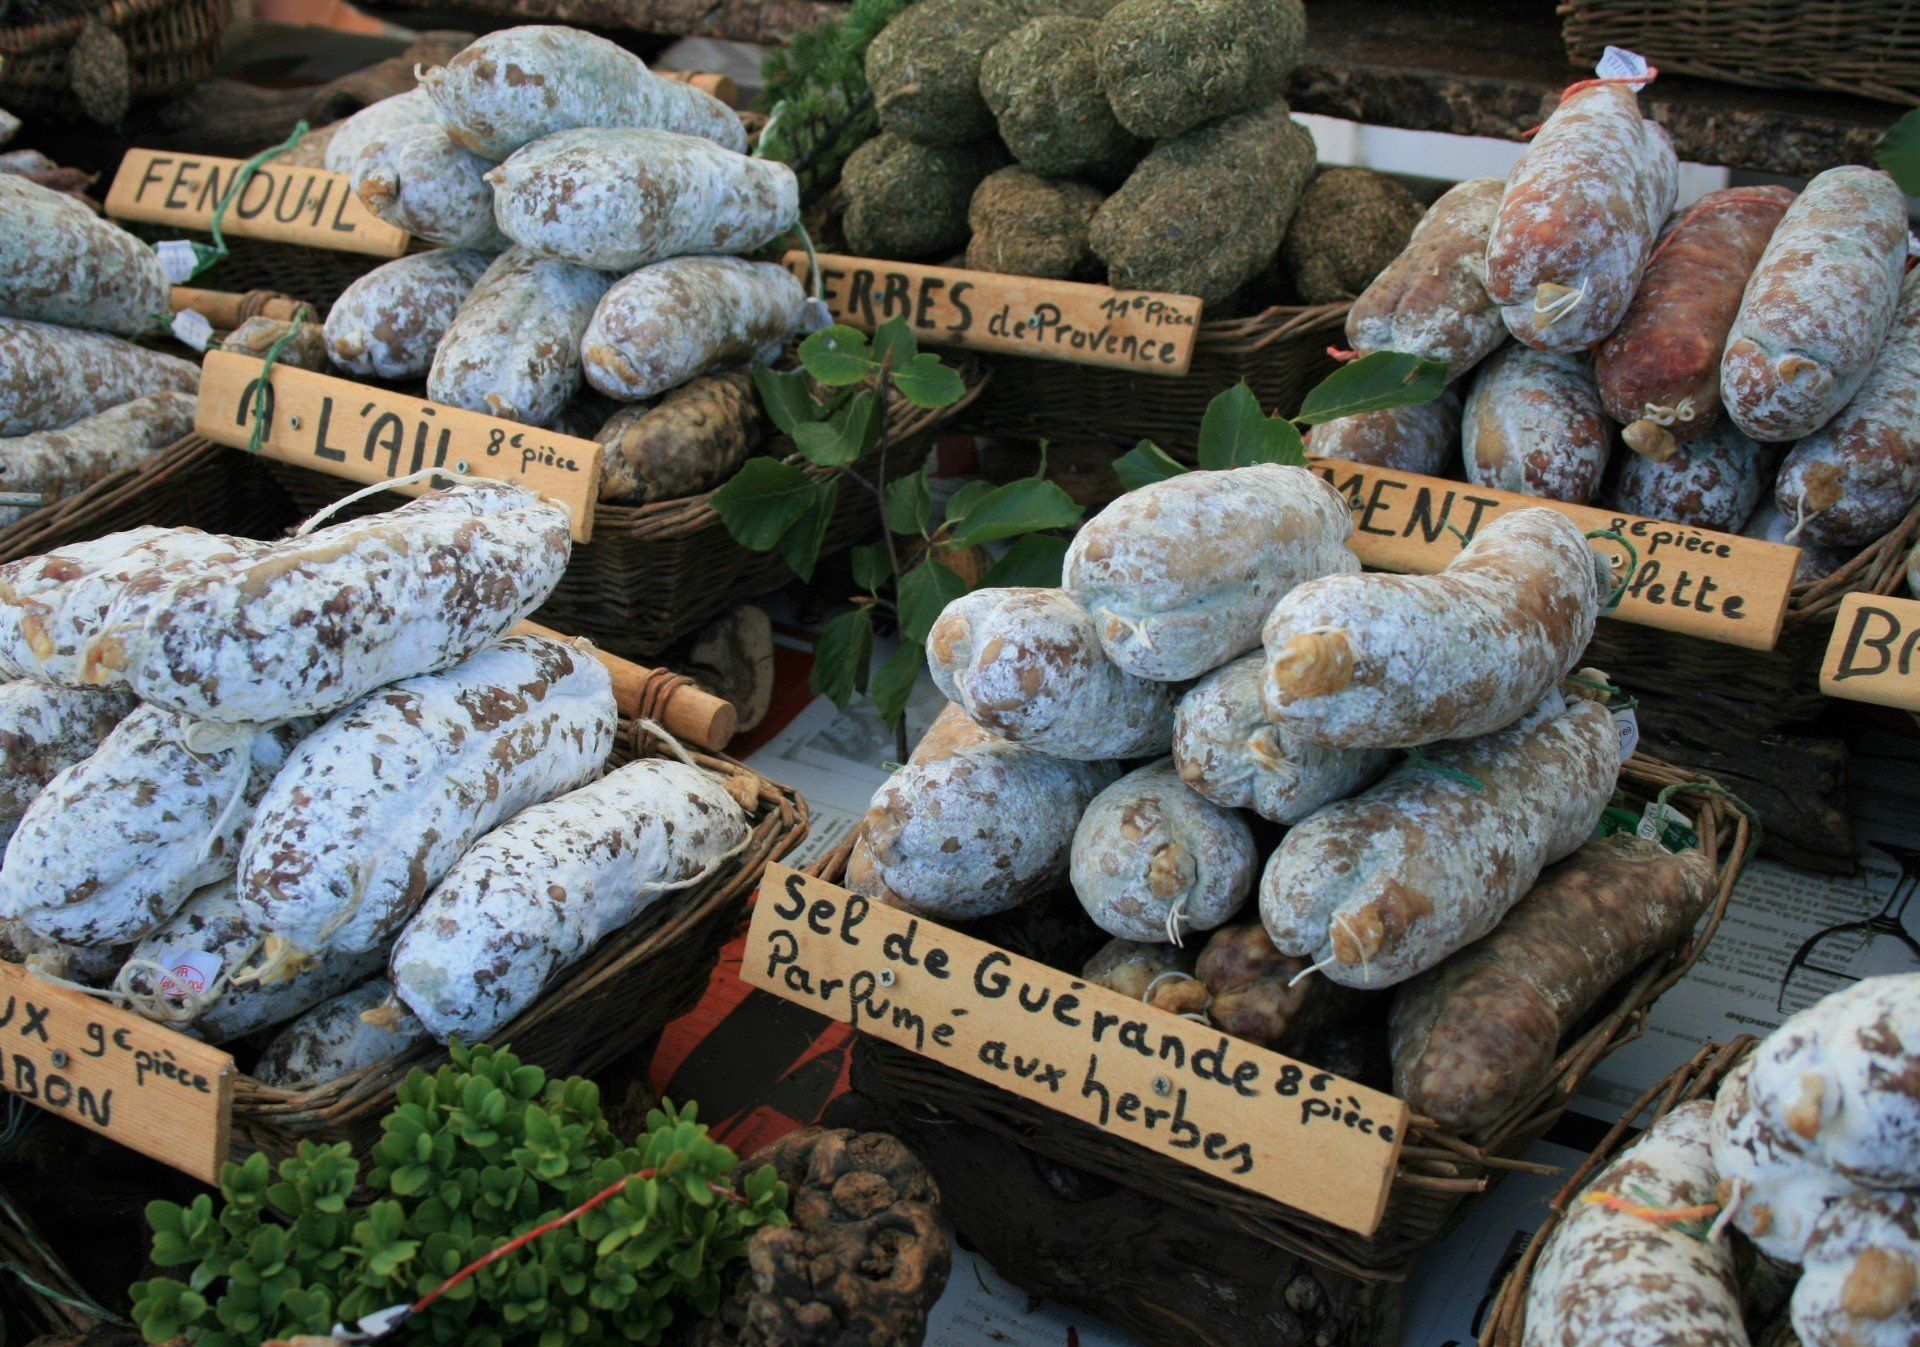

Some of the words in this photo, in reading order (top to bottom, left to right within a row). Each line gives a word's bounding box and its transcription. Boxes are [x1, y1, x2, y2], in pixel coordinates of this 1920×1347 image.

[135, 158, 355, 232] FENOUIL
[988, 304, 1026, 339] de
[1034, 302, 1176, 364] Provence
[236, 378, 275, 443] A
[521, 445, 580, 474] pièce
[1647, 530, 1731, 559] pièce
[774, 874, 869, 946] Sel
[883, 919, 950, 980] de
[973, 951, 1260, 1097] Guérande
[135, 1049, 211, 1094] pièce
[767, 929, 969, 1051] Parfumé
[978, 1040, 1067, 1093] aux
[1081, 1053, 1254, 1174] herbes
[0, 1047, 113, 1127] BON
[1301, 1096, 1395, 1143] pièce
